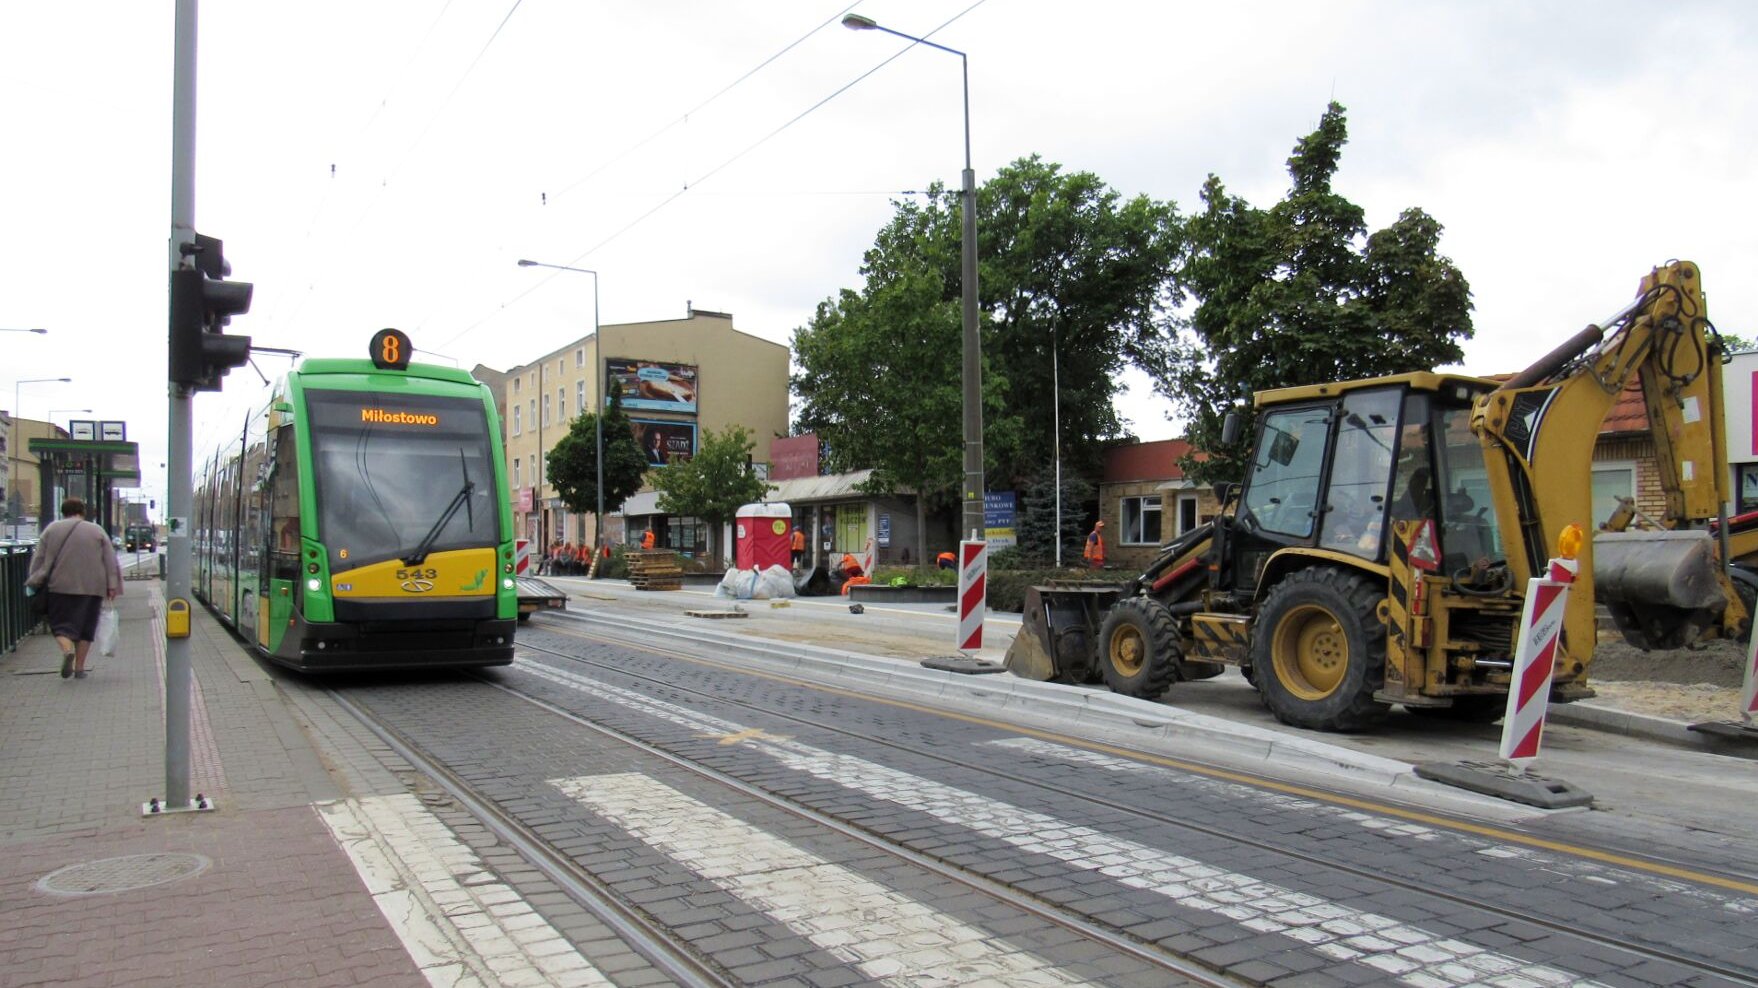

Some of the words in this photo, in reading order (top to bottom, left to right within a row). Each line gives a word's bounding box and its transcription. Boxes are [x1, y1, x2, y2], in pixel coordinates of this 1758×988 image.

[382, 335, 399, 364] 8
[361, 409, 437, 425] Miłostowo
[339, 550, 347, 558] 6
[396, 569, 438, 580] 543
